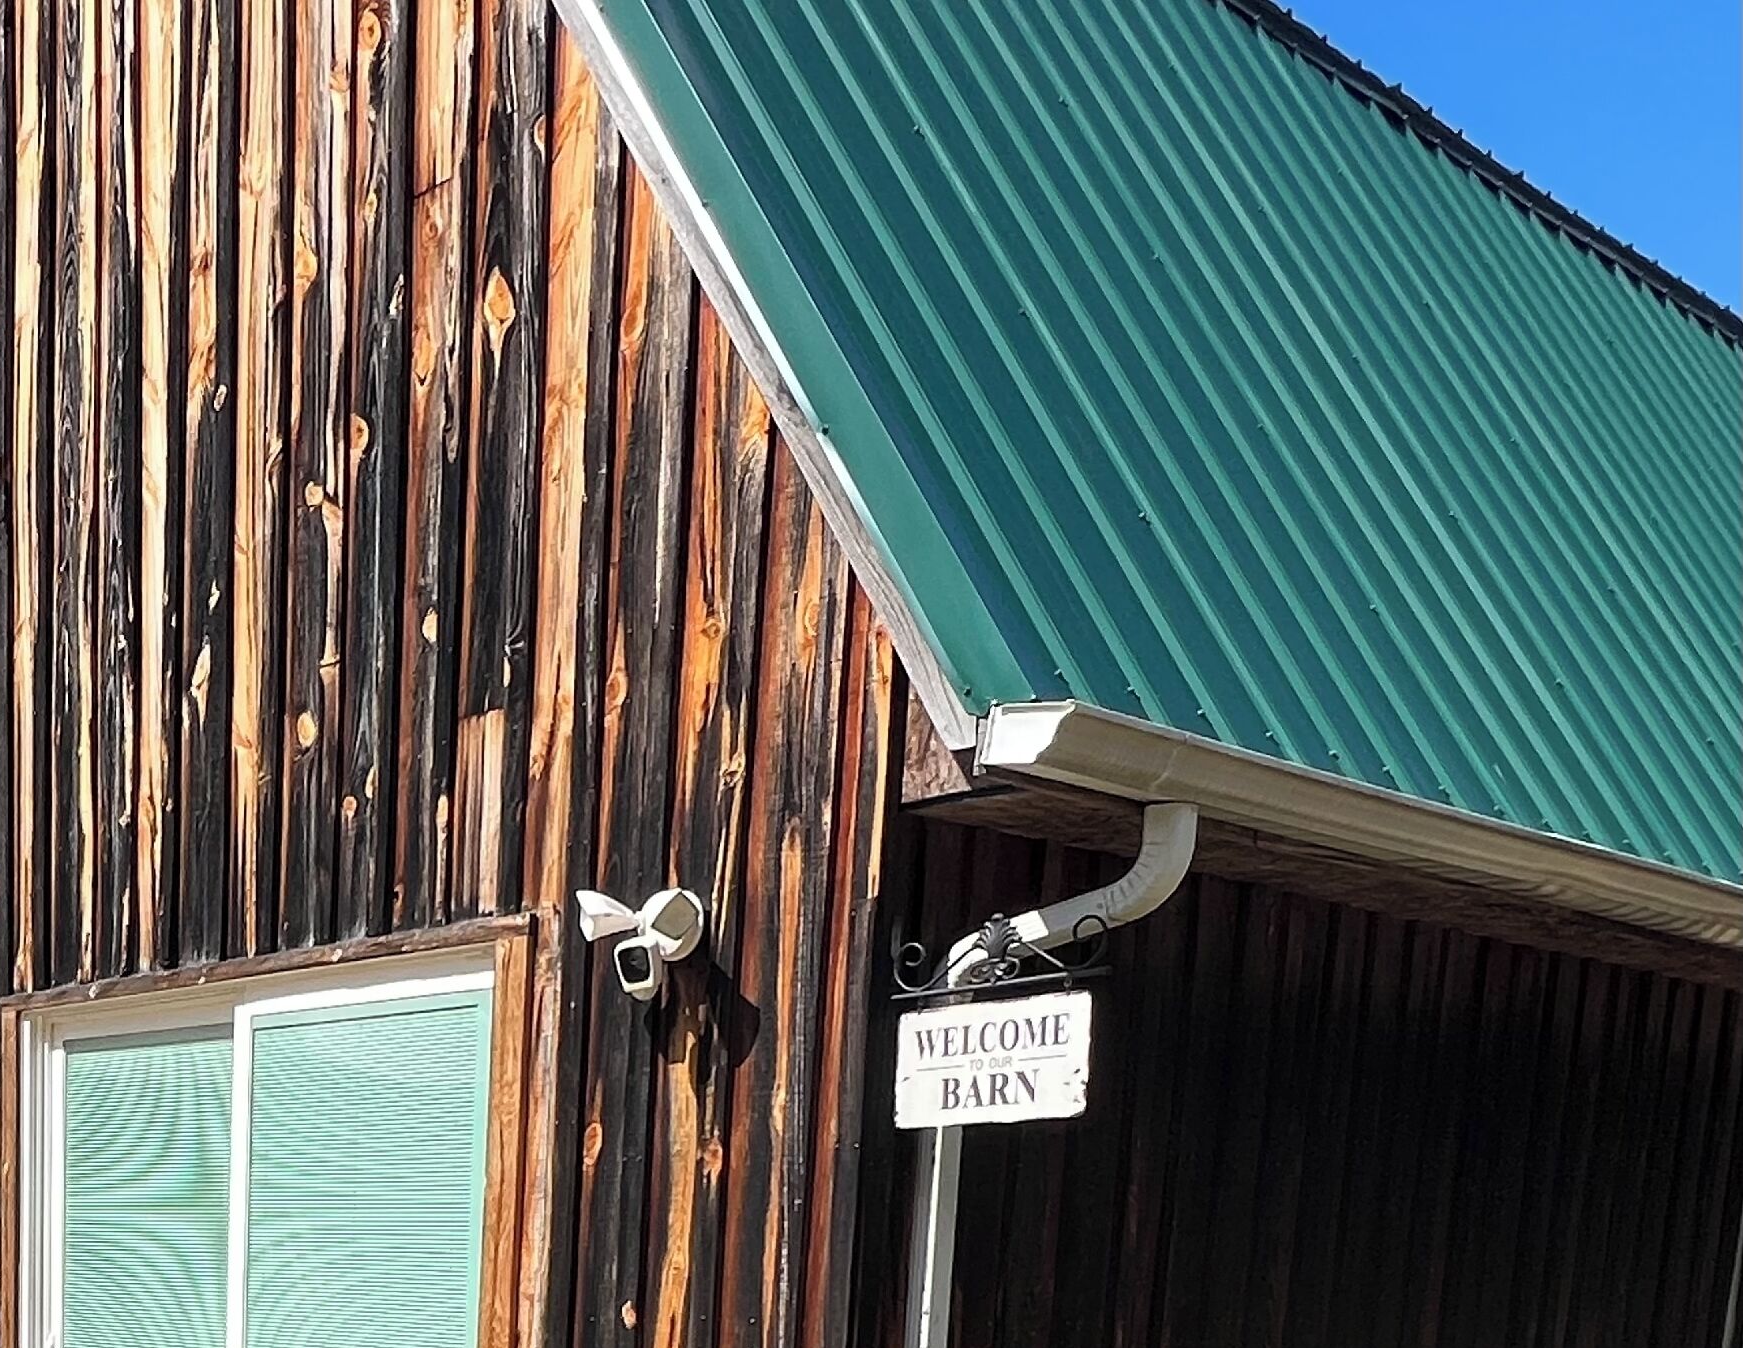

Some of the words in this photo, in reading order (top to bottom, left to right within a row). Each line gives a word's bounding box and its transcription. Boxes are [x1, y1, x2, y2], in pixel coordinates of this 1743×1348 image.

[915, 1013, 1071, 1060] WELCOME
[969, 1058, 984, 1072] TO
[989, 1056, 1013, 1069] OUR
[940, 1069, 1041, 1110] BARN
